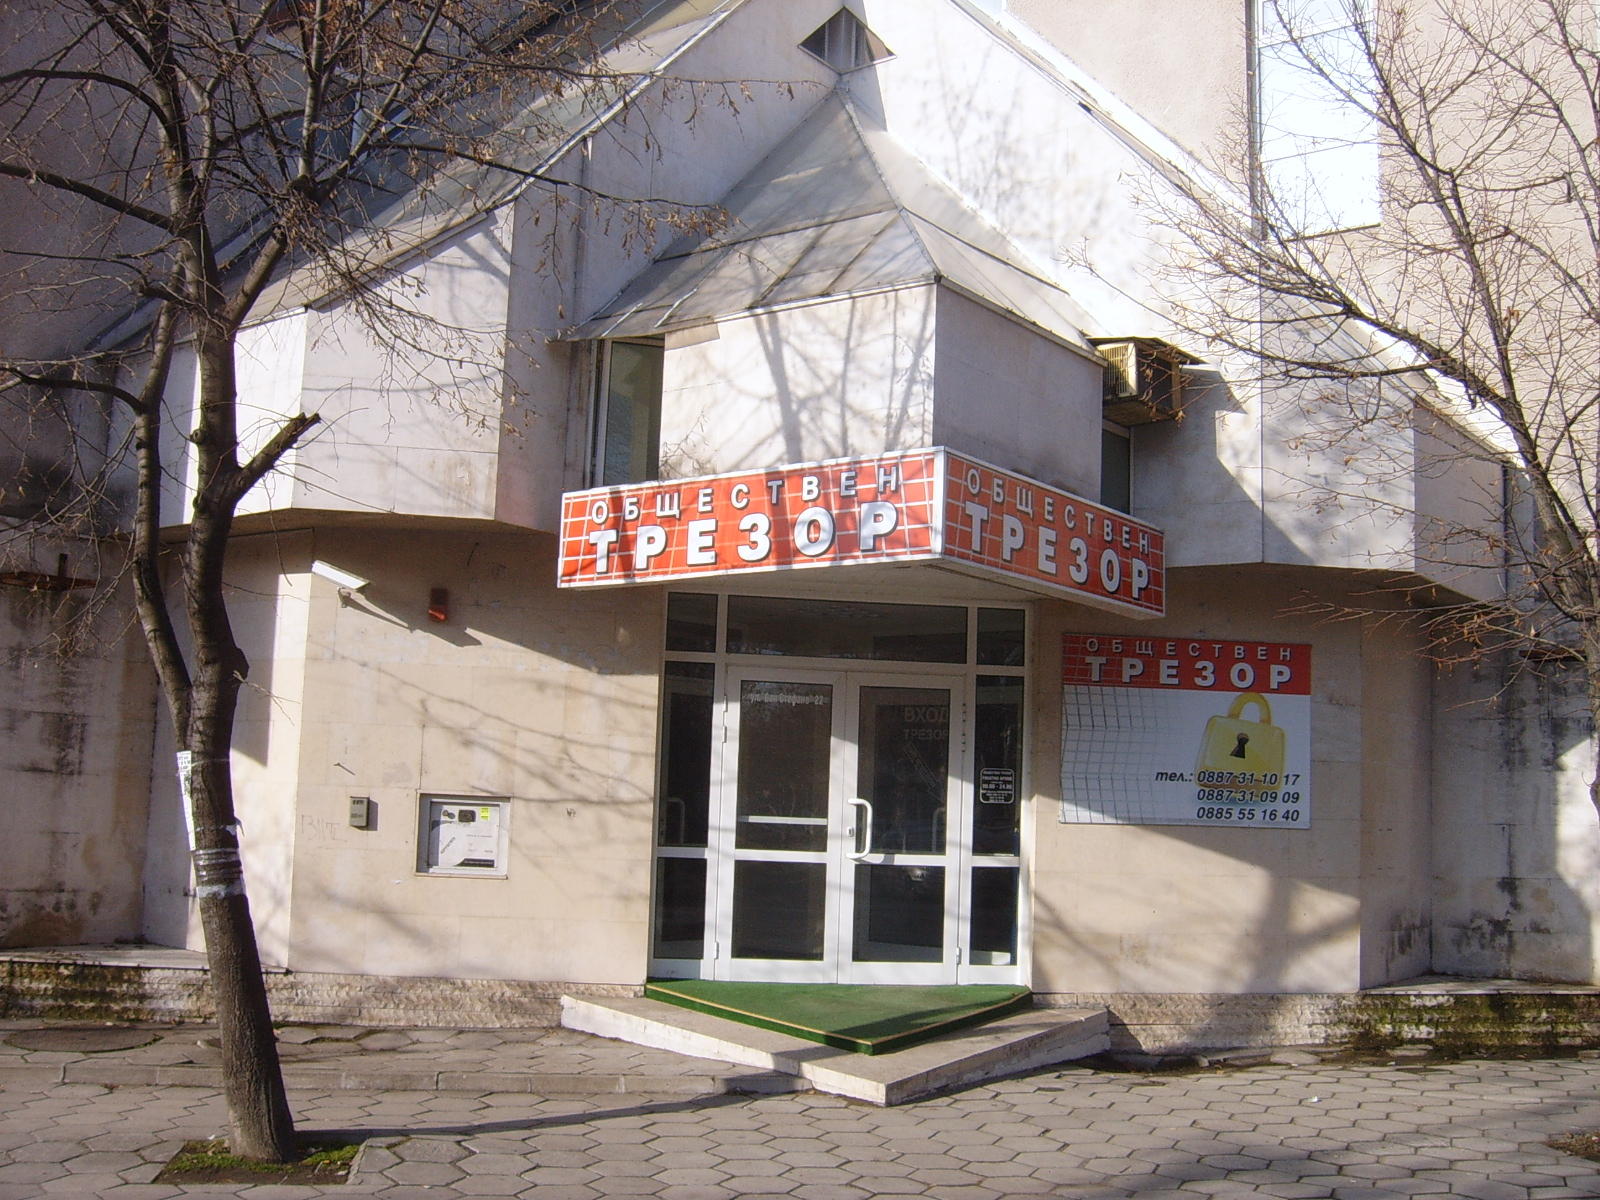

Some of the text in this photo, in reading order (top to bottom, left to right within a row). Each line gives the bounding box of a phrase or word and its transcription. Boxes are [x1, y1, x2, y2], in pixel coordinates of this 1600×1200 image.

[591, 465, 899, 525] ОБЩЕСТВЕН
[966, 468, 1150, 556] ОБЩЕСТВЕН
[588, 500, 898, 575] ТРЕЗОР
[965, 499, 1149, 600] ТРЕЗОР
[1086, 638, 1292, 661] ОБЩЕСТВЕН
[1085, 655, 1292, 690] ТРЕЗОР
[1197, 770, 1234, 784] 0887
[1237, 772, 1255, 785] 31
[1261, 773, 1278, 786] 10
[1283, 774, 1300, 786] 17
[1197, 788, 1300, 804] 0887 31 09 09
[1196, 806, 1300, 822] 0885 55 16 40
